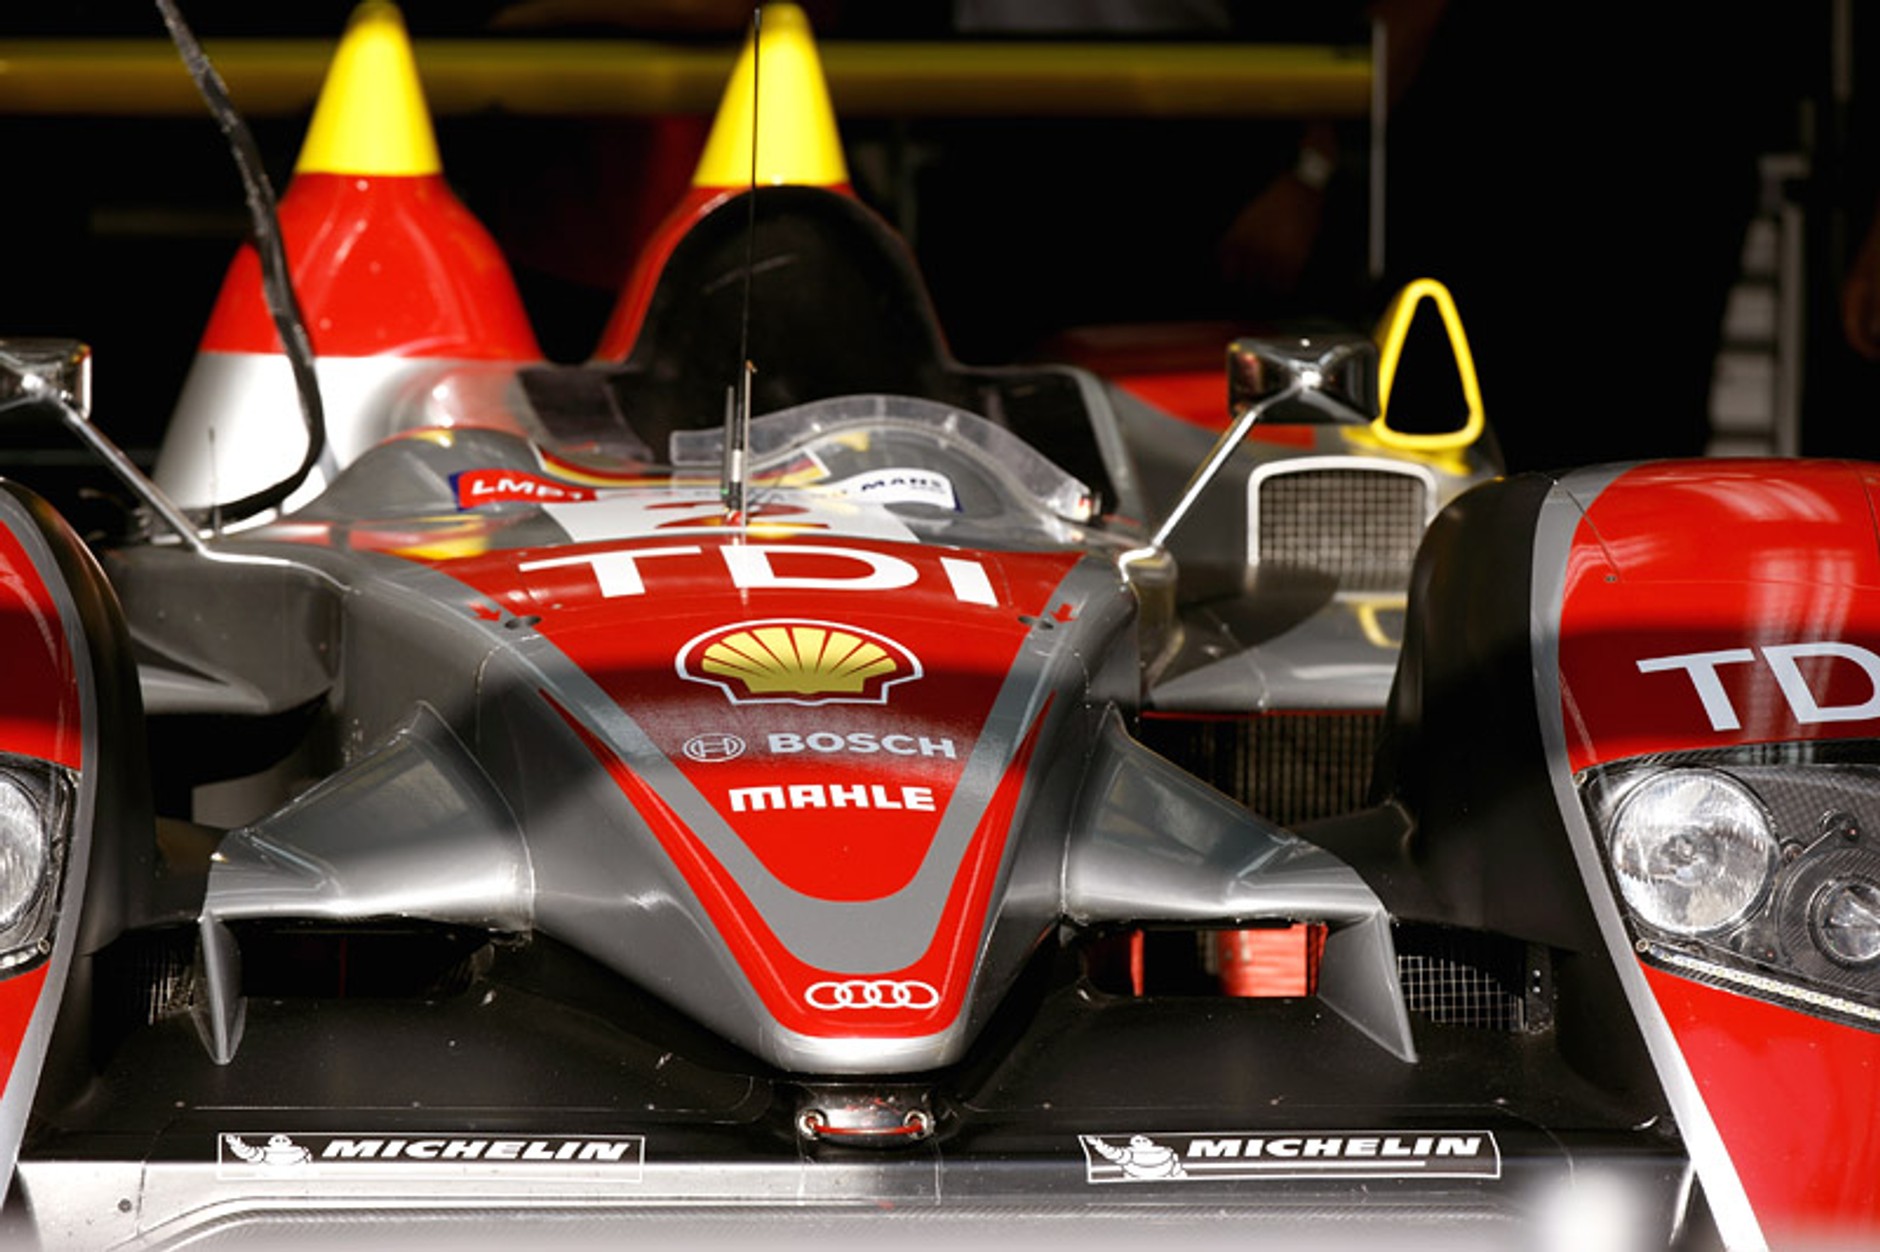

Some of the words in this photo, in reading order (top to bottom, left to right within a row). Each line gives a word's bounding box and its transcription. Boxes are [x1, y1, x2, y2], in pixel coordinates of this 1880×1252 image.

[518, 544, 999, 607] TDI
[1635, 641, 1880, 732] TD
[767, 731, 958, 760] BOSCH
[728, 784, 937, 812] MAHLE
[321, 1139, 630, 1161] MICHELIN
[1185, 1137, 1482, 1158] MICHELIN
